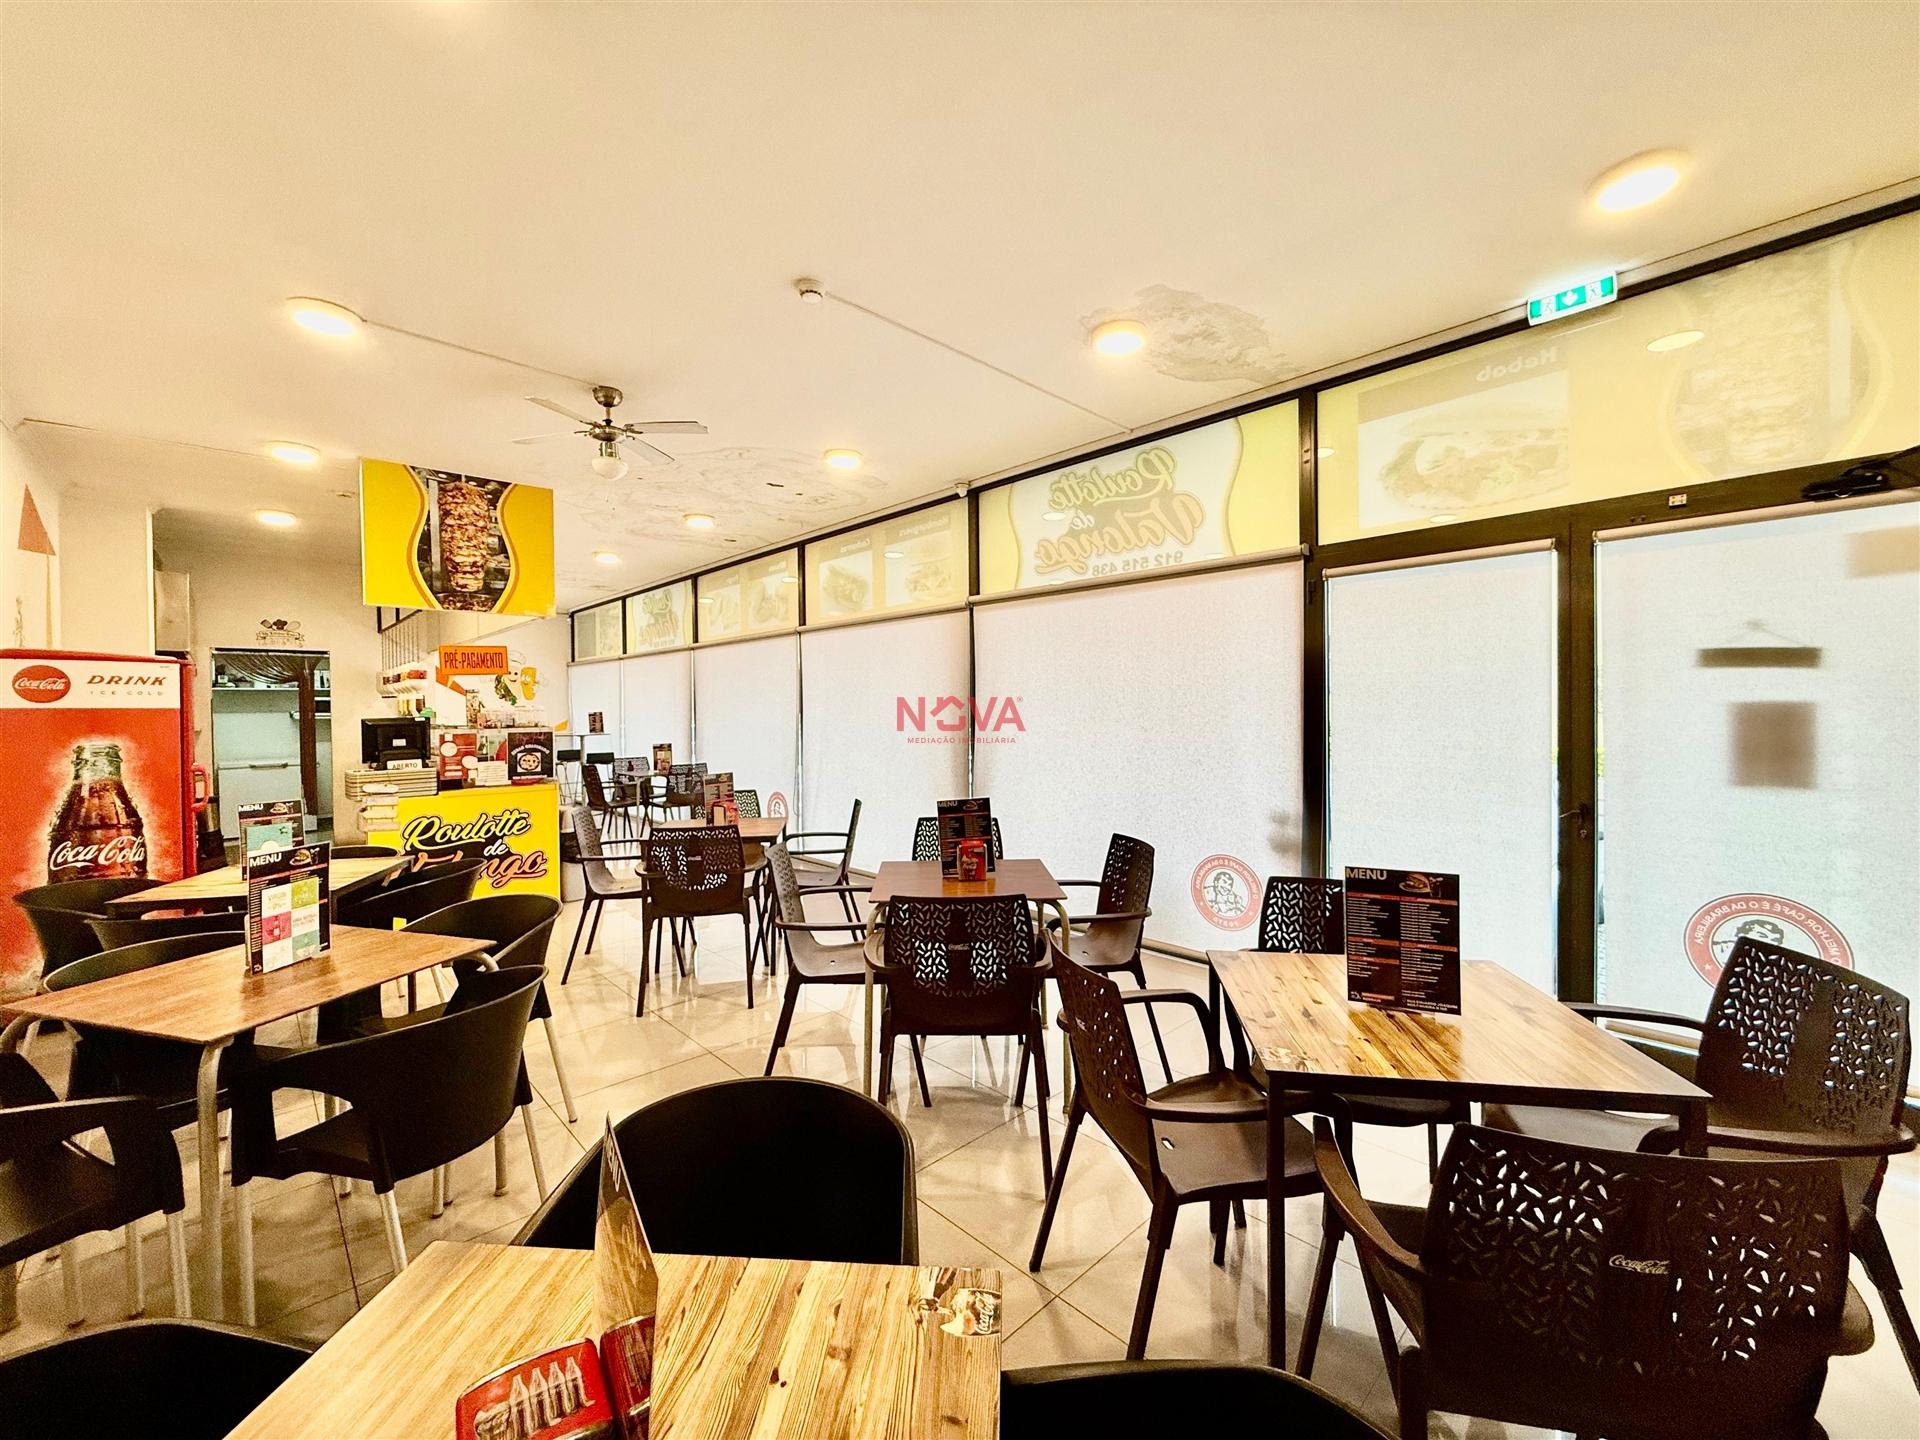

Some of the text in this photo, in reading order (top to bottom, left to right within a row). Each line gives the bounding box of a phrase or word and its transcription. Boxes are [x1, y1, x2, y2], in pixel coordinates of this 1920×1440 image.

[444, 649, 503, 669] PRÉ-PAGAMENTO
[87, 675, 166, 686] DRINK
[238, 803, 264, 812] MENU
[402, 809, 531, 851] Roulotte
[50, 835, 145, 871] Coca-Cola
[483, 839, 509, 857] de
[249, 852, 282, 867] MENU
[1345, 867, 1387, 881] MENU
